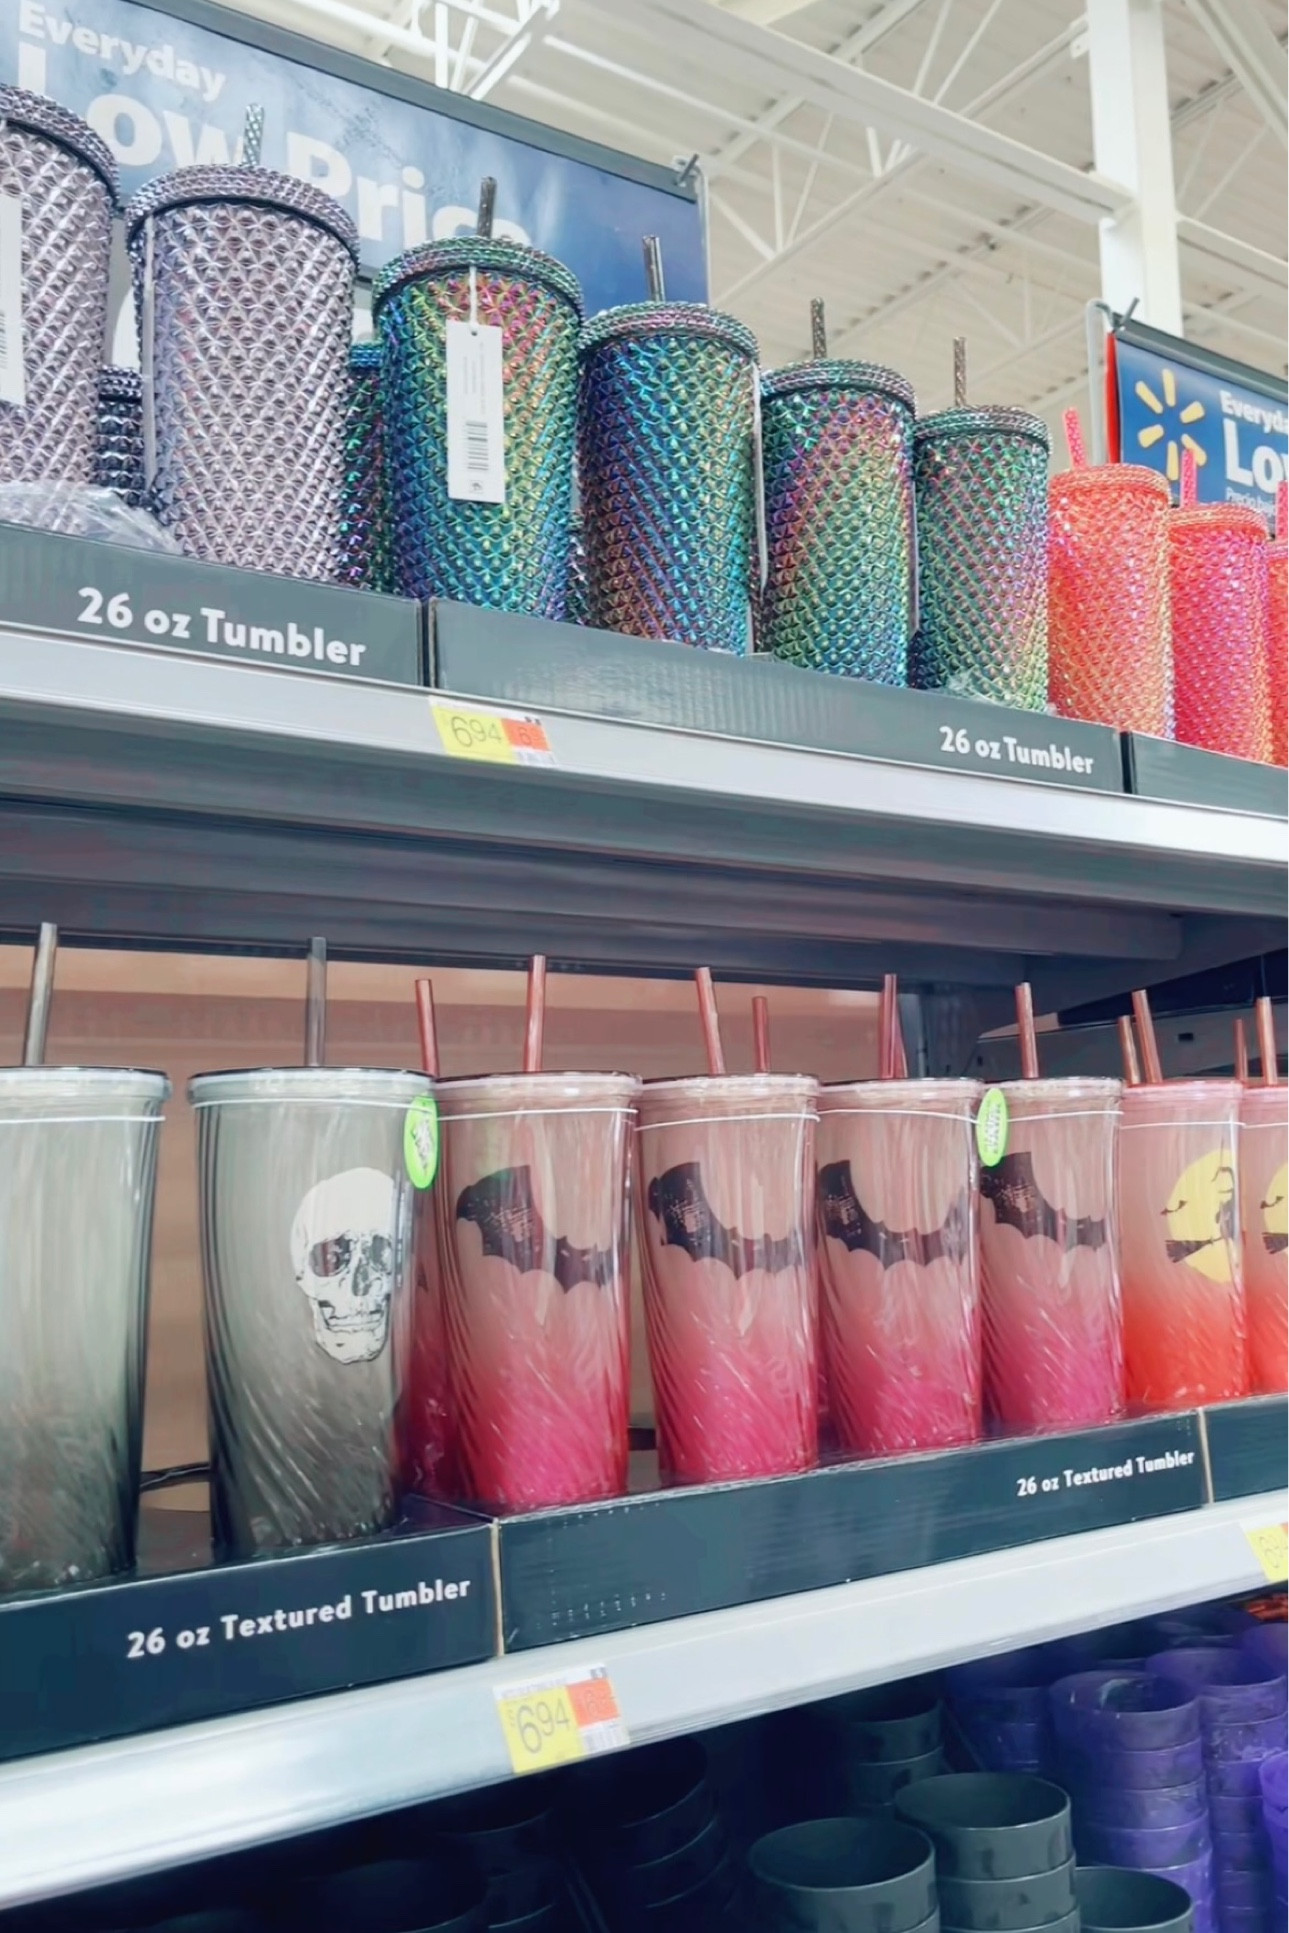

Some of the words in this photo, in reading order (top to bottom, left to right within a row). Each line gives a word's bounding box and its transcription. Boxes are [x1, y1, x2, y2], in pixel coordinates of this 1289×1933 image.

[19, 2, 226, 101] Everyday
[1223, 418, 1288, 494] Lo
[77, 586, 133, 628] 26
[144, 609, 192, 639] oz
[200, 607, 366, 666] Tumbler
[939, 725, 971, 754] 26
[975, 739, 1001, 760] oz
[1003, 736, 1094, 774] Tumbler
[1017, 1476, 1037, 1497] 26
[1041, 1479, 1060, 1492] oz
[1063, 1458, 1133, 1488] Textured
[1136, 1450, 1195, 1474] Tumbler
[126, 1627, 166, 1659] 26
[176, 1625, 211, 1648] oz
[220, 1595, 352, 1640] Textured
[361, 1579, 471, 1614] Tumbler
